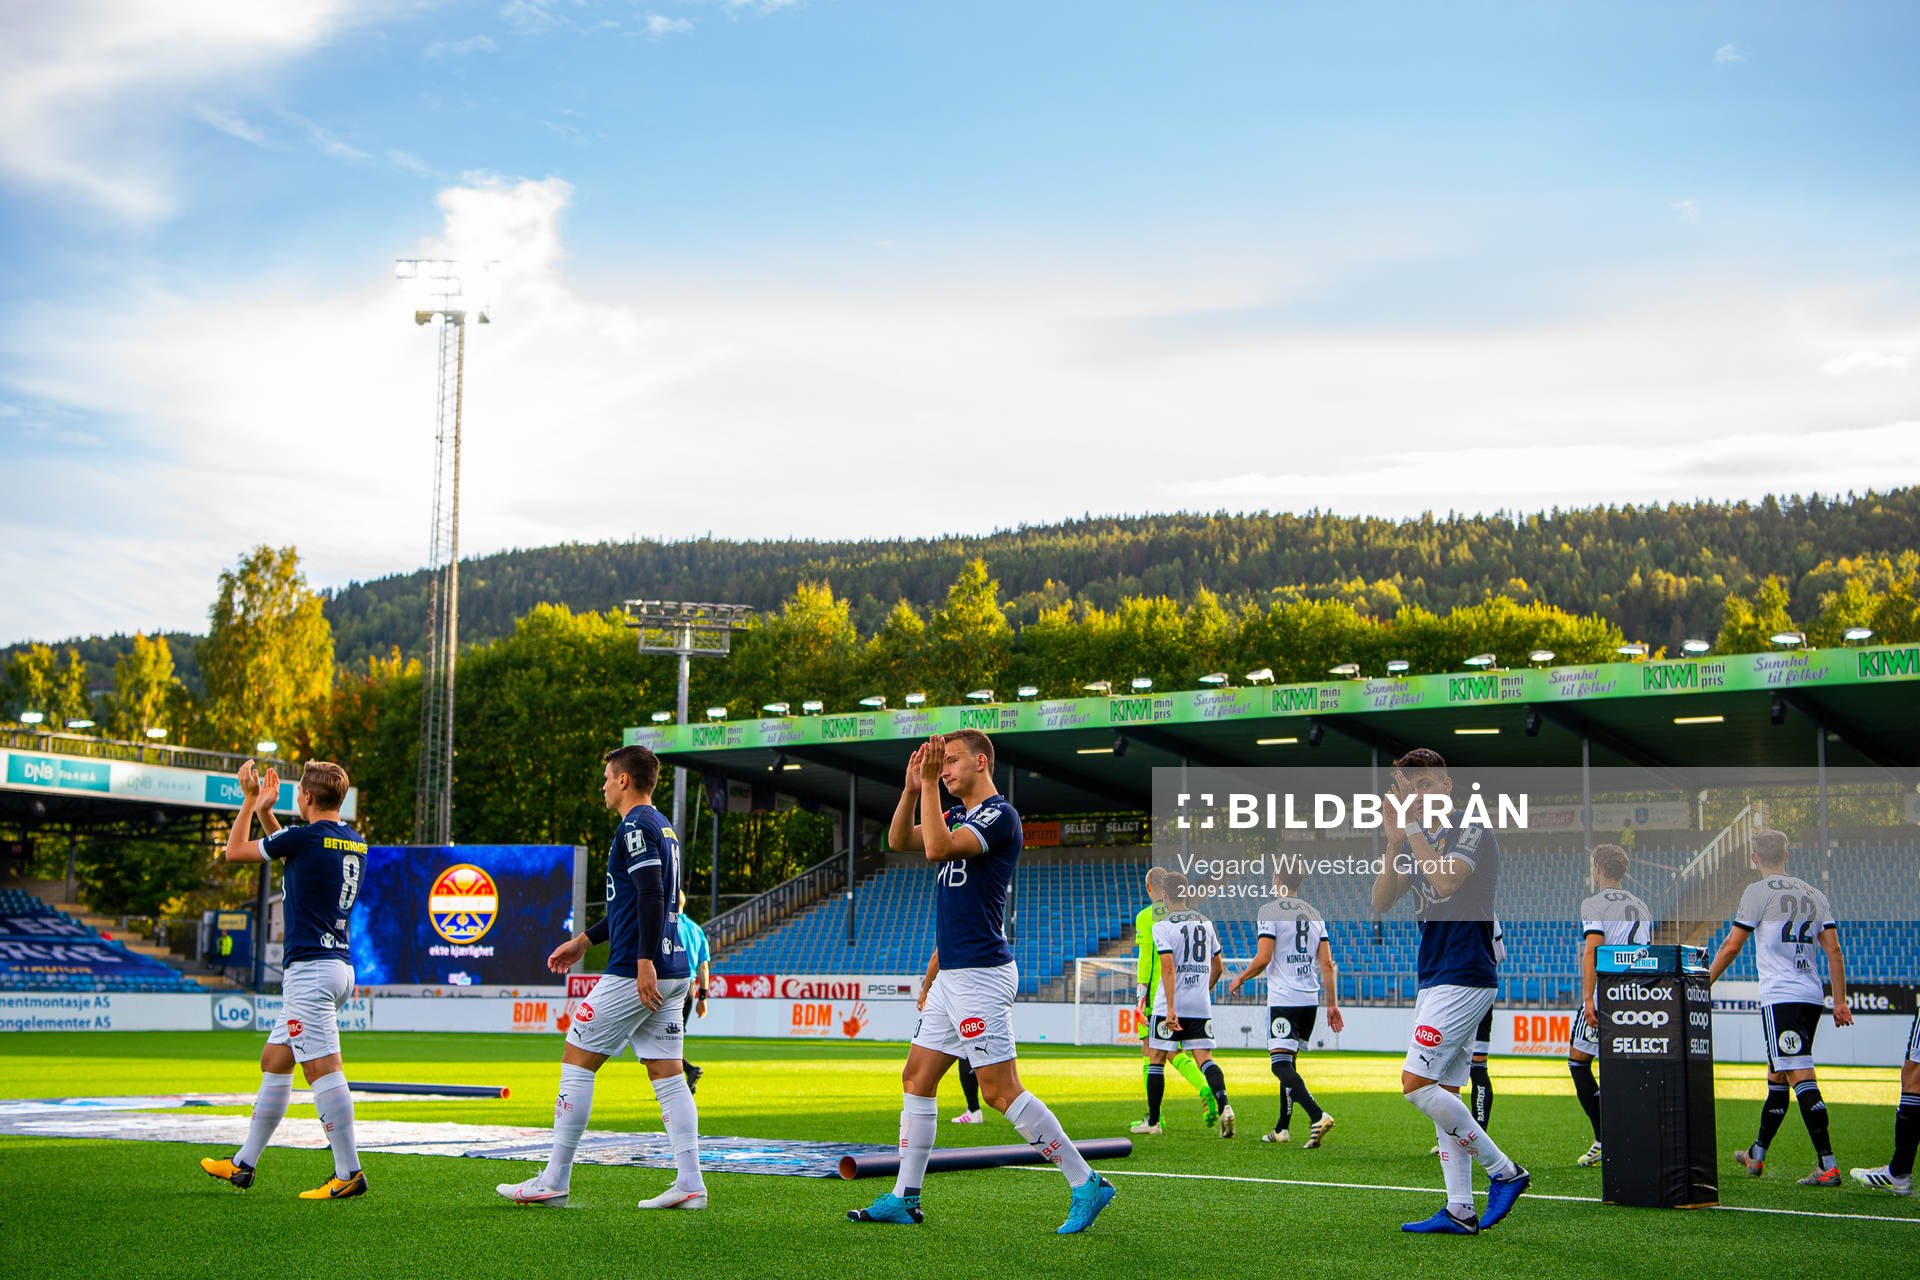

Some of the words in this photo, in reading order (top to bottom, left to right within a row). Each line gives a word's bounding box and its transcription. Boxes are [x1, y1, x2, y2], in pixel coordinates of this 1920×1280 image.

[1858, 648, 1920, 678] KIWI
[1643, 664, 1698, 689] KIWI
[1701, 661, 1726, 674] mini
[1701, 675, 1724, 688] pris
[1449, 676, 1498, 700] KIWI
[1501, 674, 1524, 686] mini
[1501, 687, 1522, 701] pris
[1272, 688, 1317, 711] KIWI
[1320, 687, 1341, 697] mini
[1320, 699, 1339, 711] pris
[960, 708, 999, 729] KIWI
[1001, 707, 1019, 718] mini
[1110, 699, 1152, 721] KIWI
[1154, 697, 1173, 708] mini
[1154, 709, 1172, 720] pris
[821, 718, 858, 738] KIWI
[1001, 719, 1017, 730] pris
[692, 726, 726, 747] KIWI
[24, 761, 54, 782] DNB
[1064, 823, 1097, 834] SELECT
[1106, 821, 1140, 833] SELECT
[339, 854, 360, 910] 8
[1624, 904, 1641, 945] 2
[1780, 894, 1817, 944] 22
[1296, 914, 1310, 953] 8
[428, 945, 449, 957] ekte
[450, 944, 495, 959] kjærlighet
[1180, 924, 1207, 963] 18
[1615, 952, 1636, 964] ELITE
[781, 978, 861, 1000] Canon
[868, 984, 896, 996] PSS
[1606, 983, 1673, 1001] altibox
[1687, 984, 1710, 1003] altibox
[93, 996, 111, 1009] AS
[94, 1015, 112, 1029] AS
[218, 1004, 250, 1022] Loe
[513, 1001, 548, 1024] BDM
[792, 1003, 832, 1027] BDM
[1611, 1010, 1669, 1029] coop
[1689, 1011, 1709, 1030] coop
[960, 1020, 986, 1034] ARBO
[1514, 1015, 1570, 1043] BDM
[1415, 1030, 1443, 1044] ARBO
[1612, 1037, 1670, 1054] SELECT
[1690, 1038, 1710, 1055] SELECT
